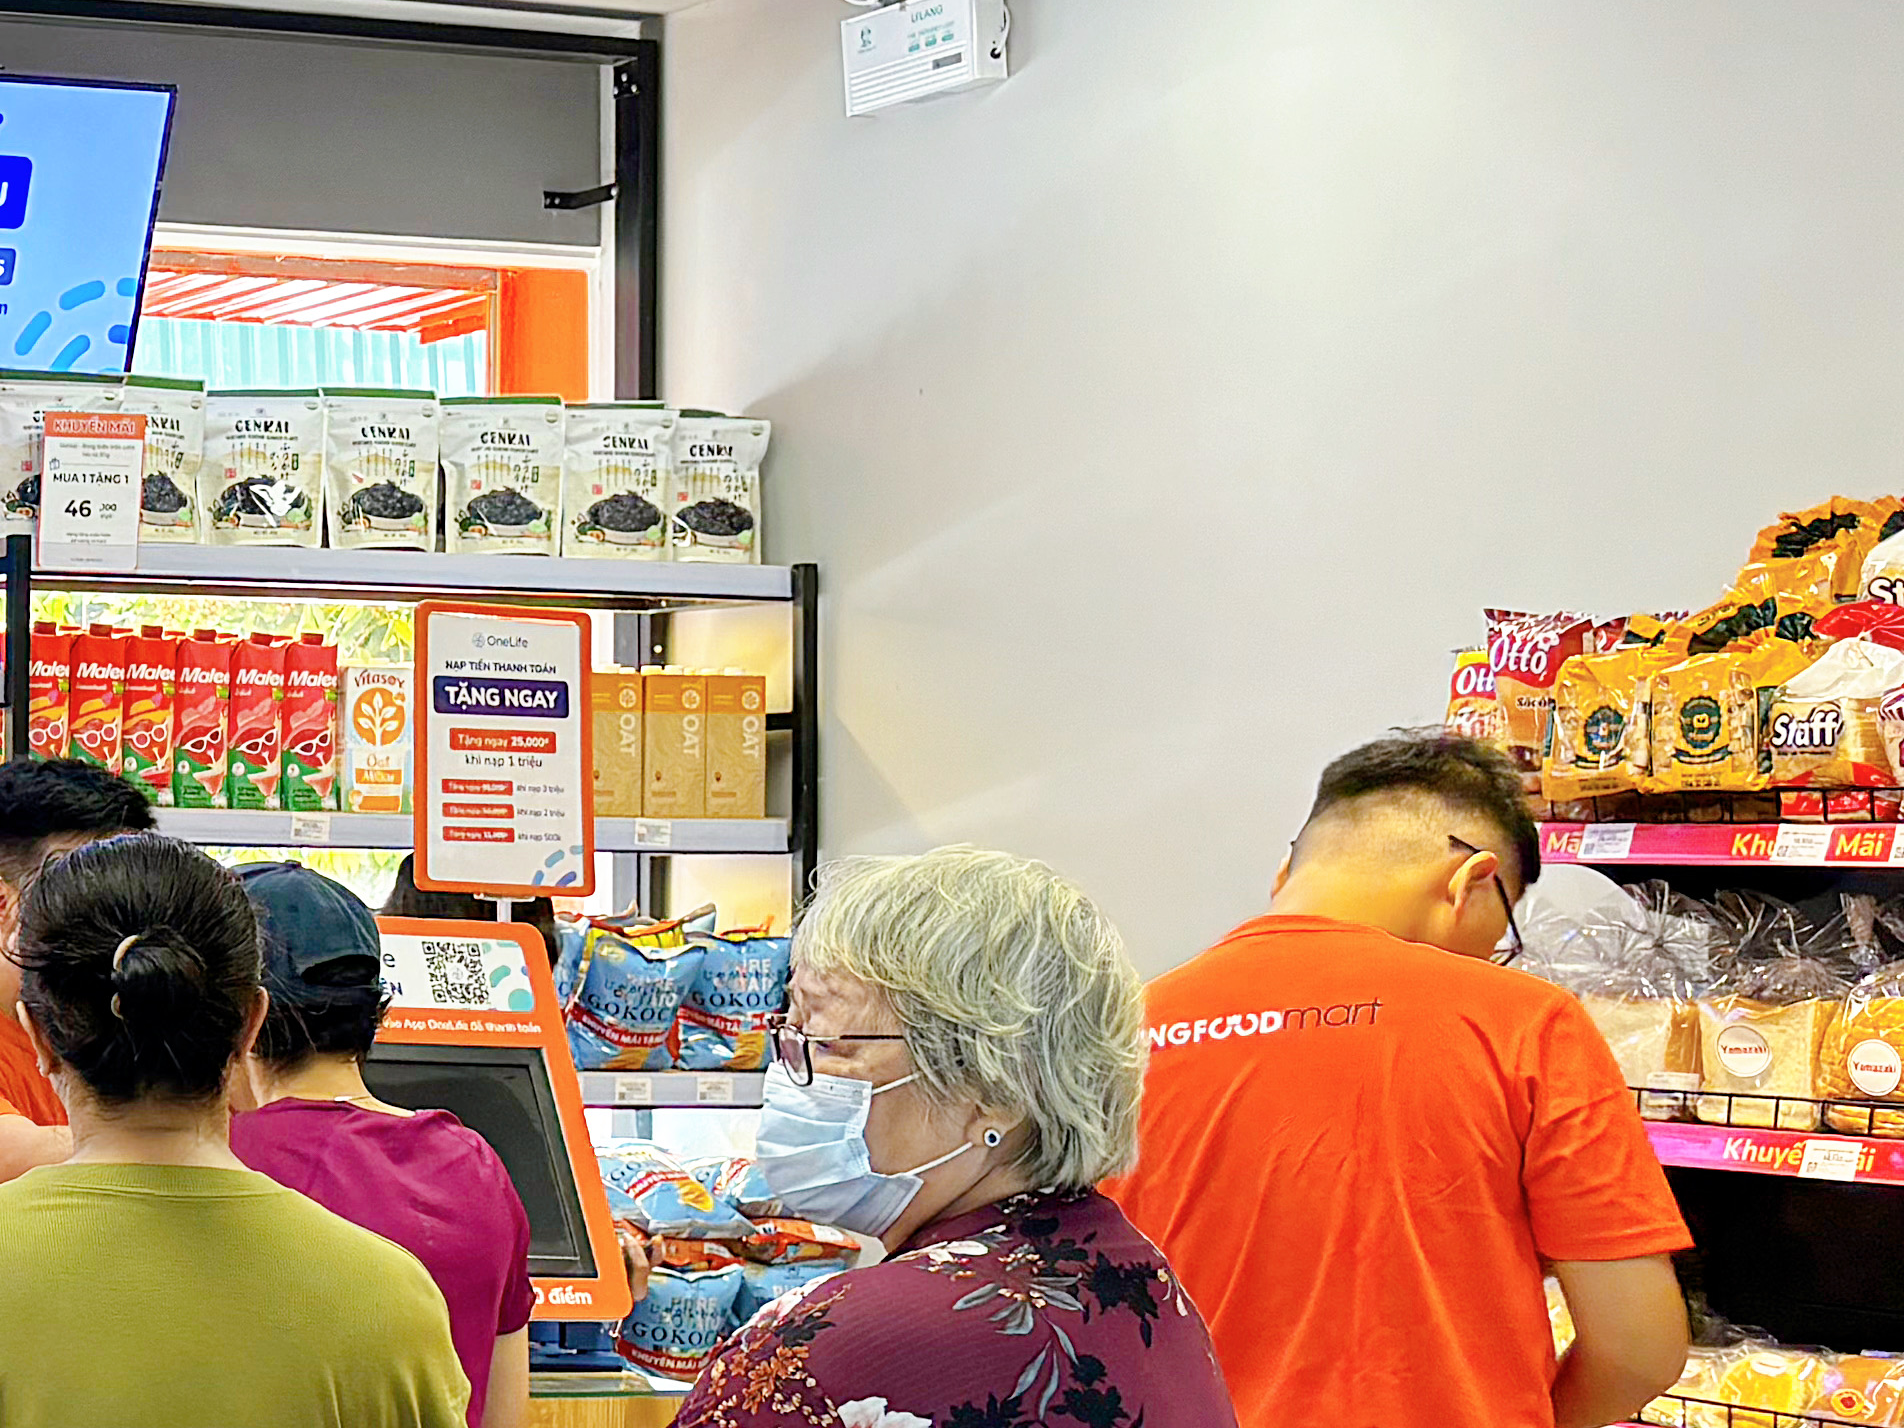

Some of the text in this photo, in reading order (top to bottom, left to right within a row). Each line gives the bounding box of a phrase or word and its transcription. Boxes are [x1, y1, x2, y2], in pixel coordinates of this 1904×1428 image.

[52, 473, 78, 486] MUA
[87, 473, 121, 487] TẶNG
[65, 501, 91, 518] 46
[487, 635, 528, 648] OneLife
[1489, 632, 1548, 675] Otto
[354, 668, 404, 687] Vitasoy
[444, 682, 558, 710] TẶNG NGAY
[620, 714, 636, 757] OAT
[1771, 710, 1839, 749] Staff
[1835, 832, 1883, 858] Mãi
[1141, 997, 1383, 1047] NGFOODmart
[1723, 1137, 1805, 1169] Khuyế
